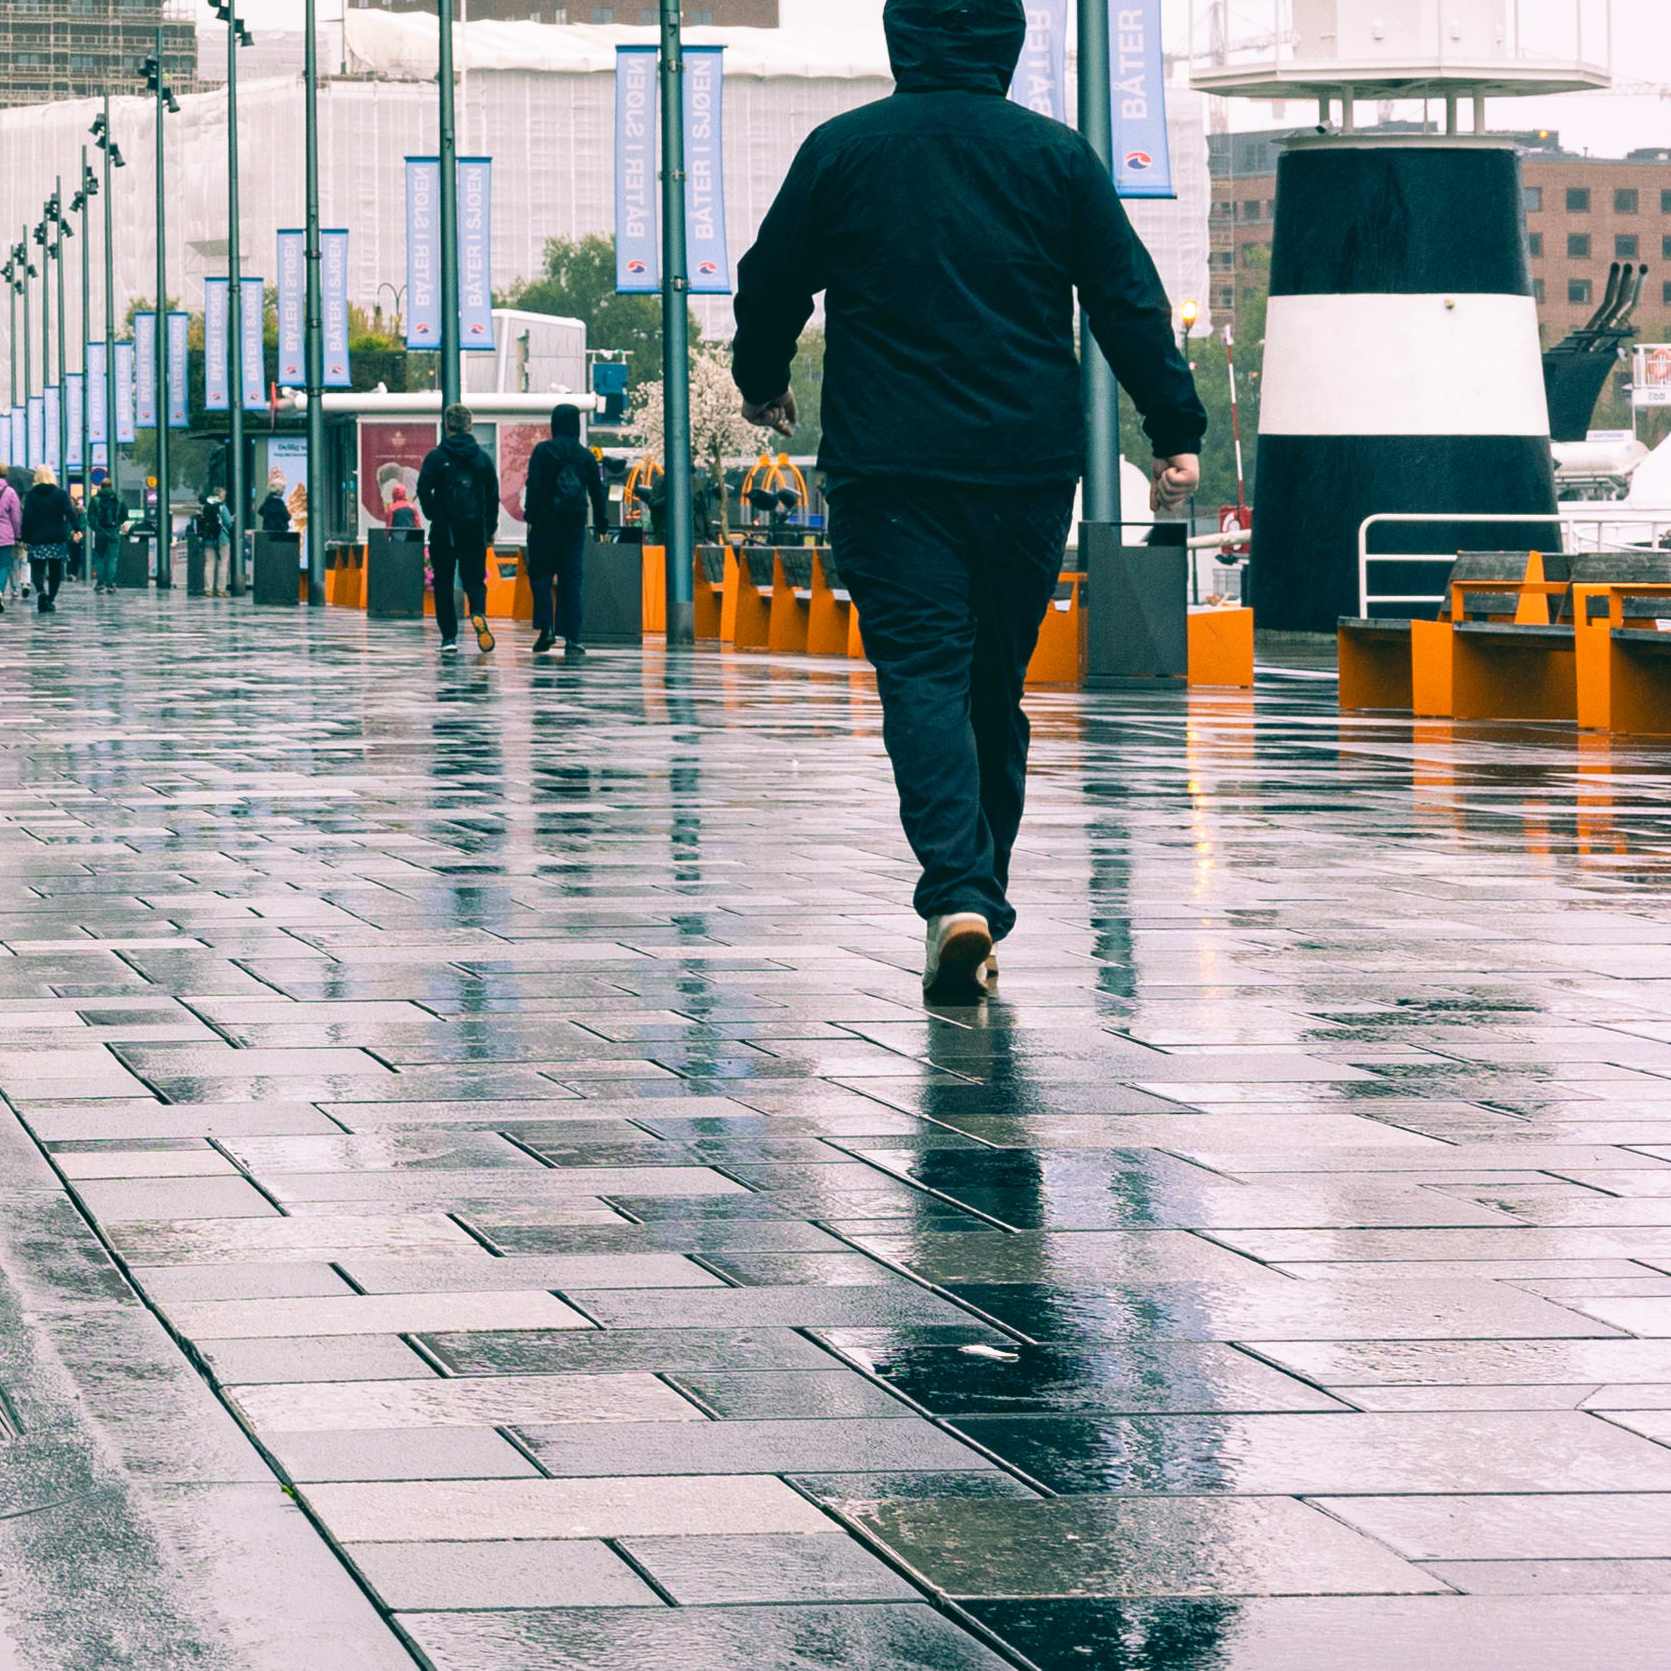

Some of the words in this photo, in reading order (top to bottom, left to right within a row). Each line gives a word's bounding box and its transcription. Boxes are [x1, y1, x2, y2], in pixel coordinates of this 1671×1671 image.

[692, 60, 710, 139] SJØEN
[1112, 8, 1148, 120] BÅTER
[467, 168, 483, 229] SJØEN
[691, 160, 714, 239] BÅTER
[464, 245, 483, 306] BÅTER
